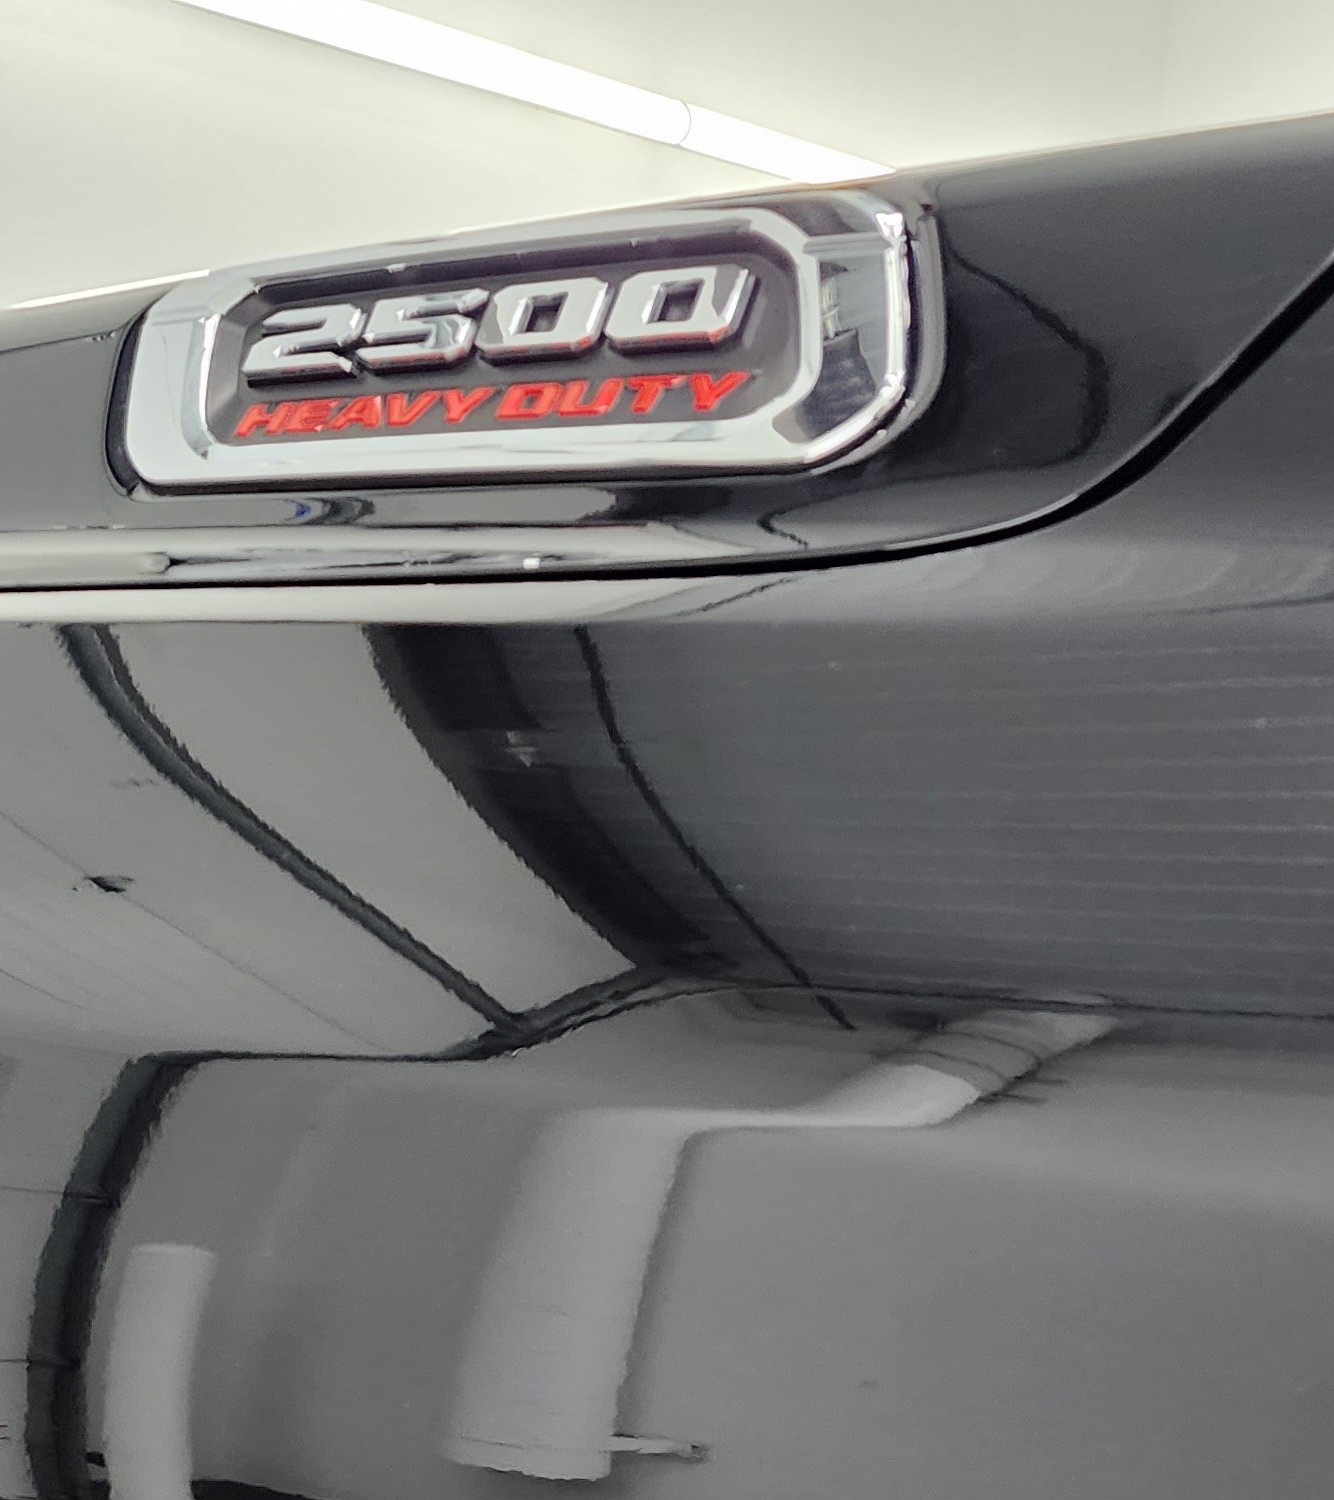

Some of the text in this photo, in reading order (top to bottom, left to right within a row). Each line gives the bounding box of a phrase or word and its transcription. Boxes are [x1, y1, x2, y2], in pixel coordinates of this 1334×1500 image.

[241, 266, 754, 382] 2500
[235, 372, 753, 438] HEAVY DUTY
